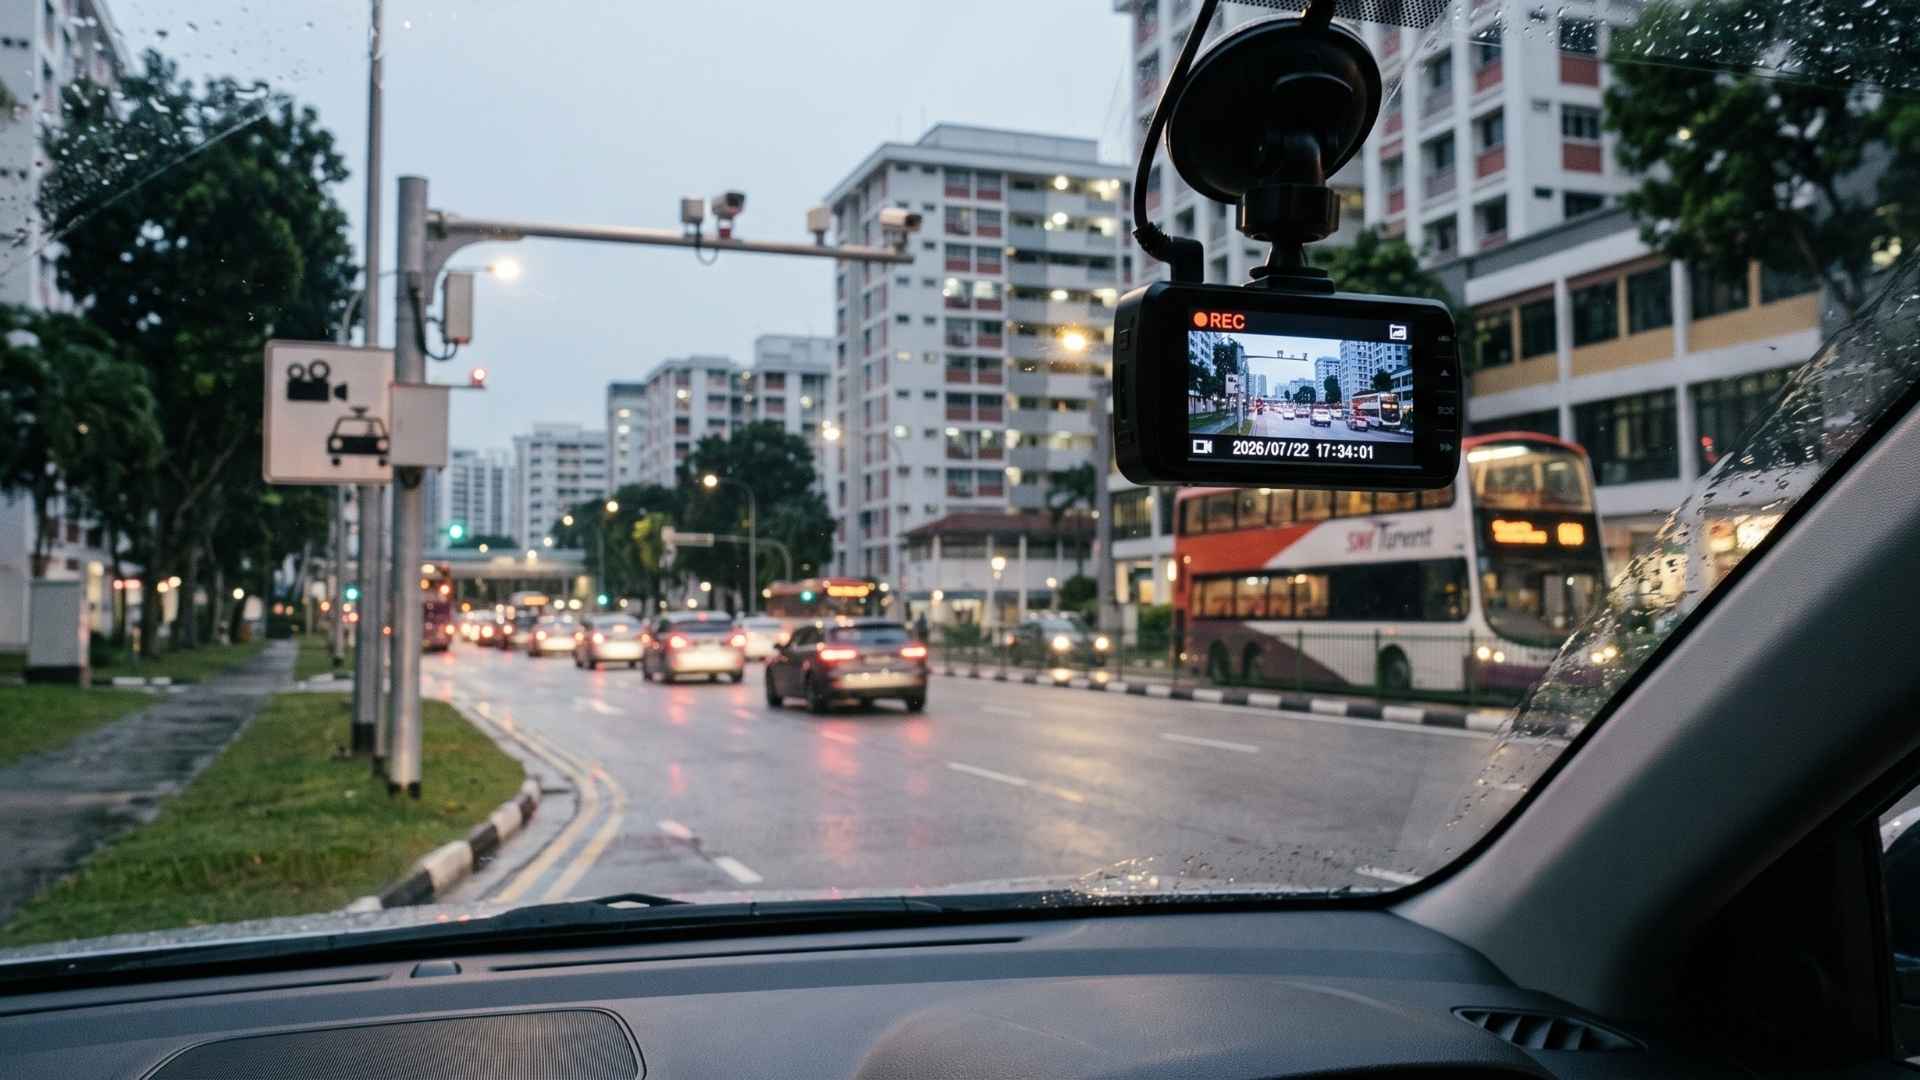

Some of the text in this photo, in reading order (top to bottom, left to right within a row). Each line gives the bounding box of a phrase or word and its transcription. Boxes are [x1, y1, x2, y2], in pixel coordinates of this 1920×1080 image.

[1210, 312, 1245, 329] REC
[1232, 440, 1374, 459] 2026/07/22 17:34:01
